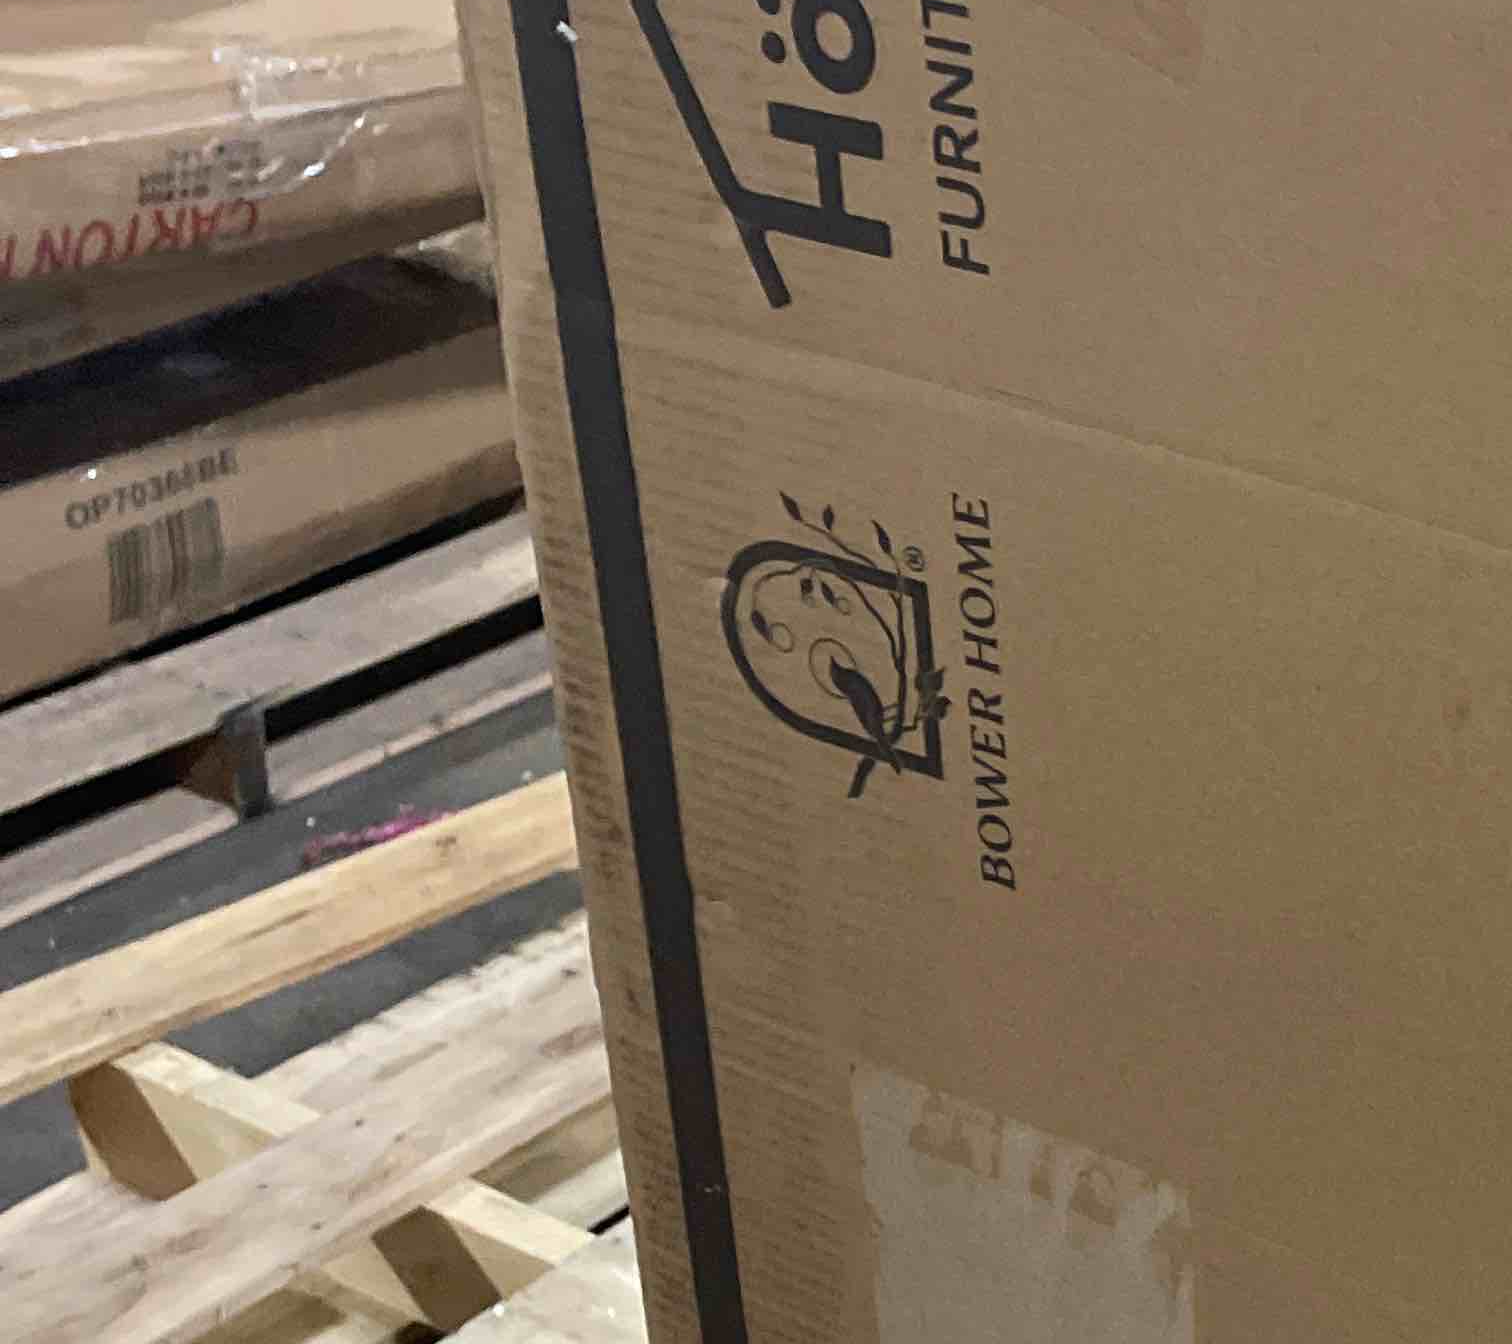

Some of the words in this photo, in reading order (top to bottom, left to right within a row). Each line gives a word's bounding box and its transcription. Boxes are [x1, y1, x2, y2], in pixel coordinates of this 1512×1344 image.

[31, 196, 259, 279] CARTON
[952, 491, 1002, 676] HOME
[967, 686, 1017, 891] BOWER
